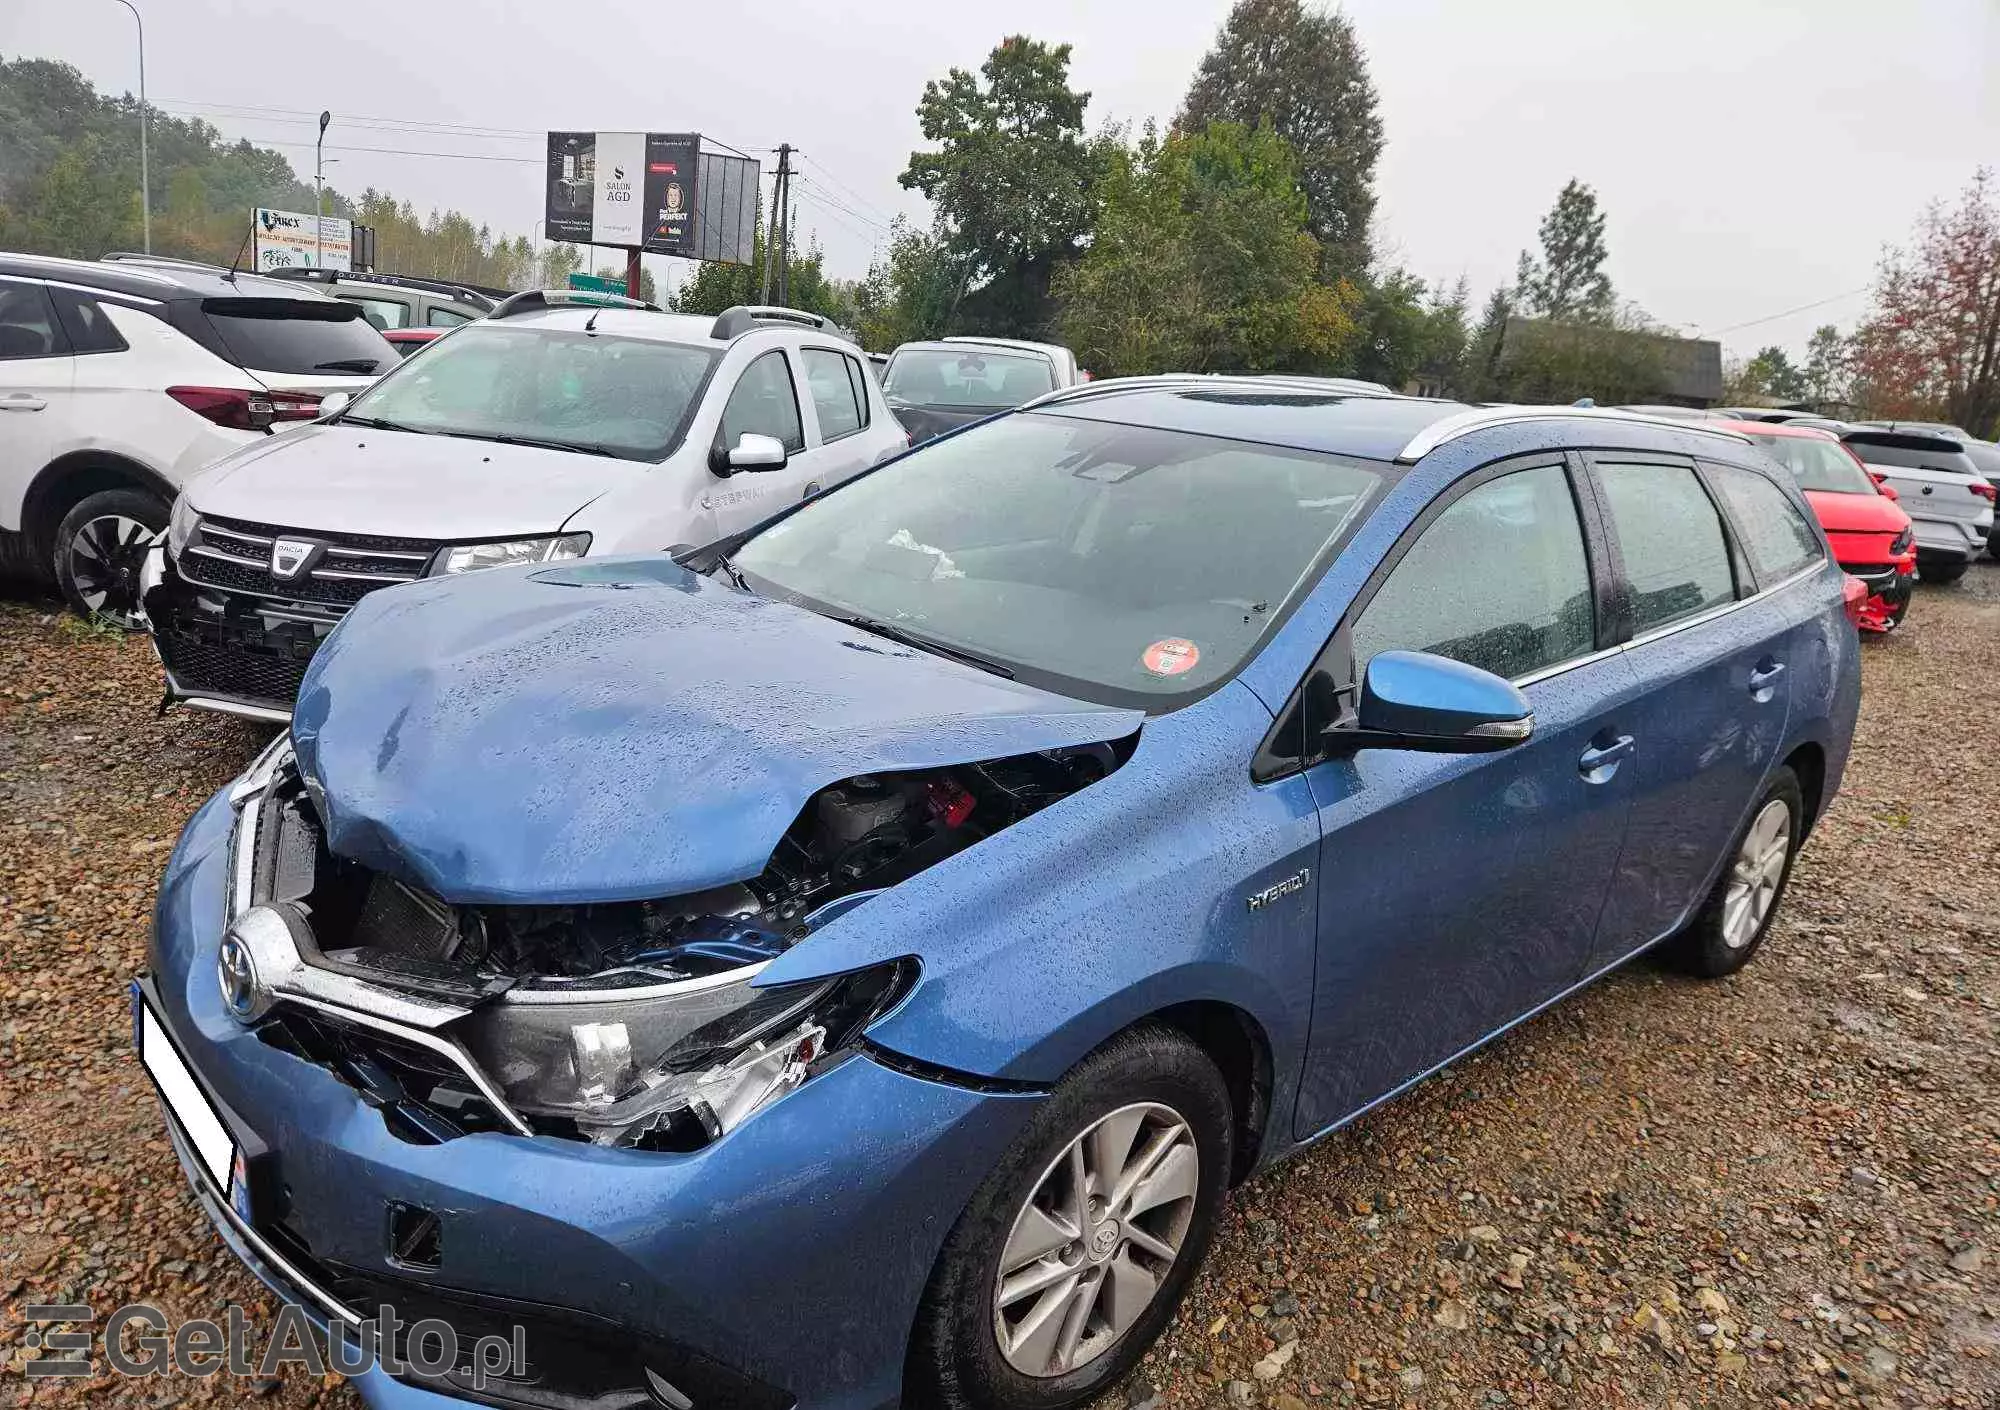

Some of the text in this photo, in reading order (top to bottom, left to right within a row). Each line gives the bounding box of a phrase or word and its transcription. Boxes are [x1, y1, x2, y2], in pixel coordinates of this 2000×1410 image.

[606, 182, 631, 190] SALON
[606, 191, 631, 201] AGD
[659, 212, 688, 221] PERFEKT
[279, 545, 304, 553] DACIA
[1246, 874, 1303, 913] HYBRID
